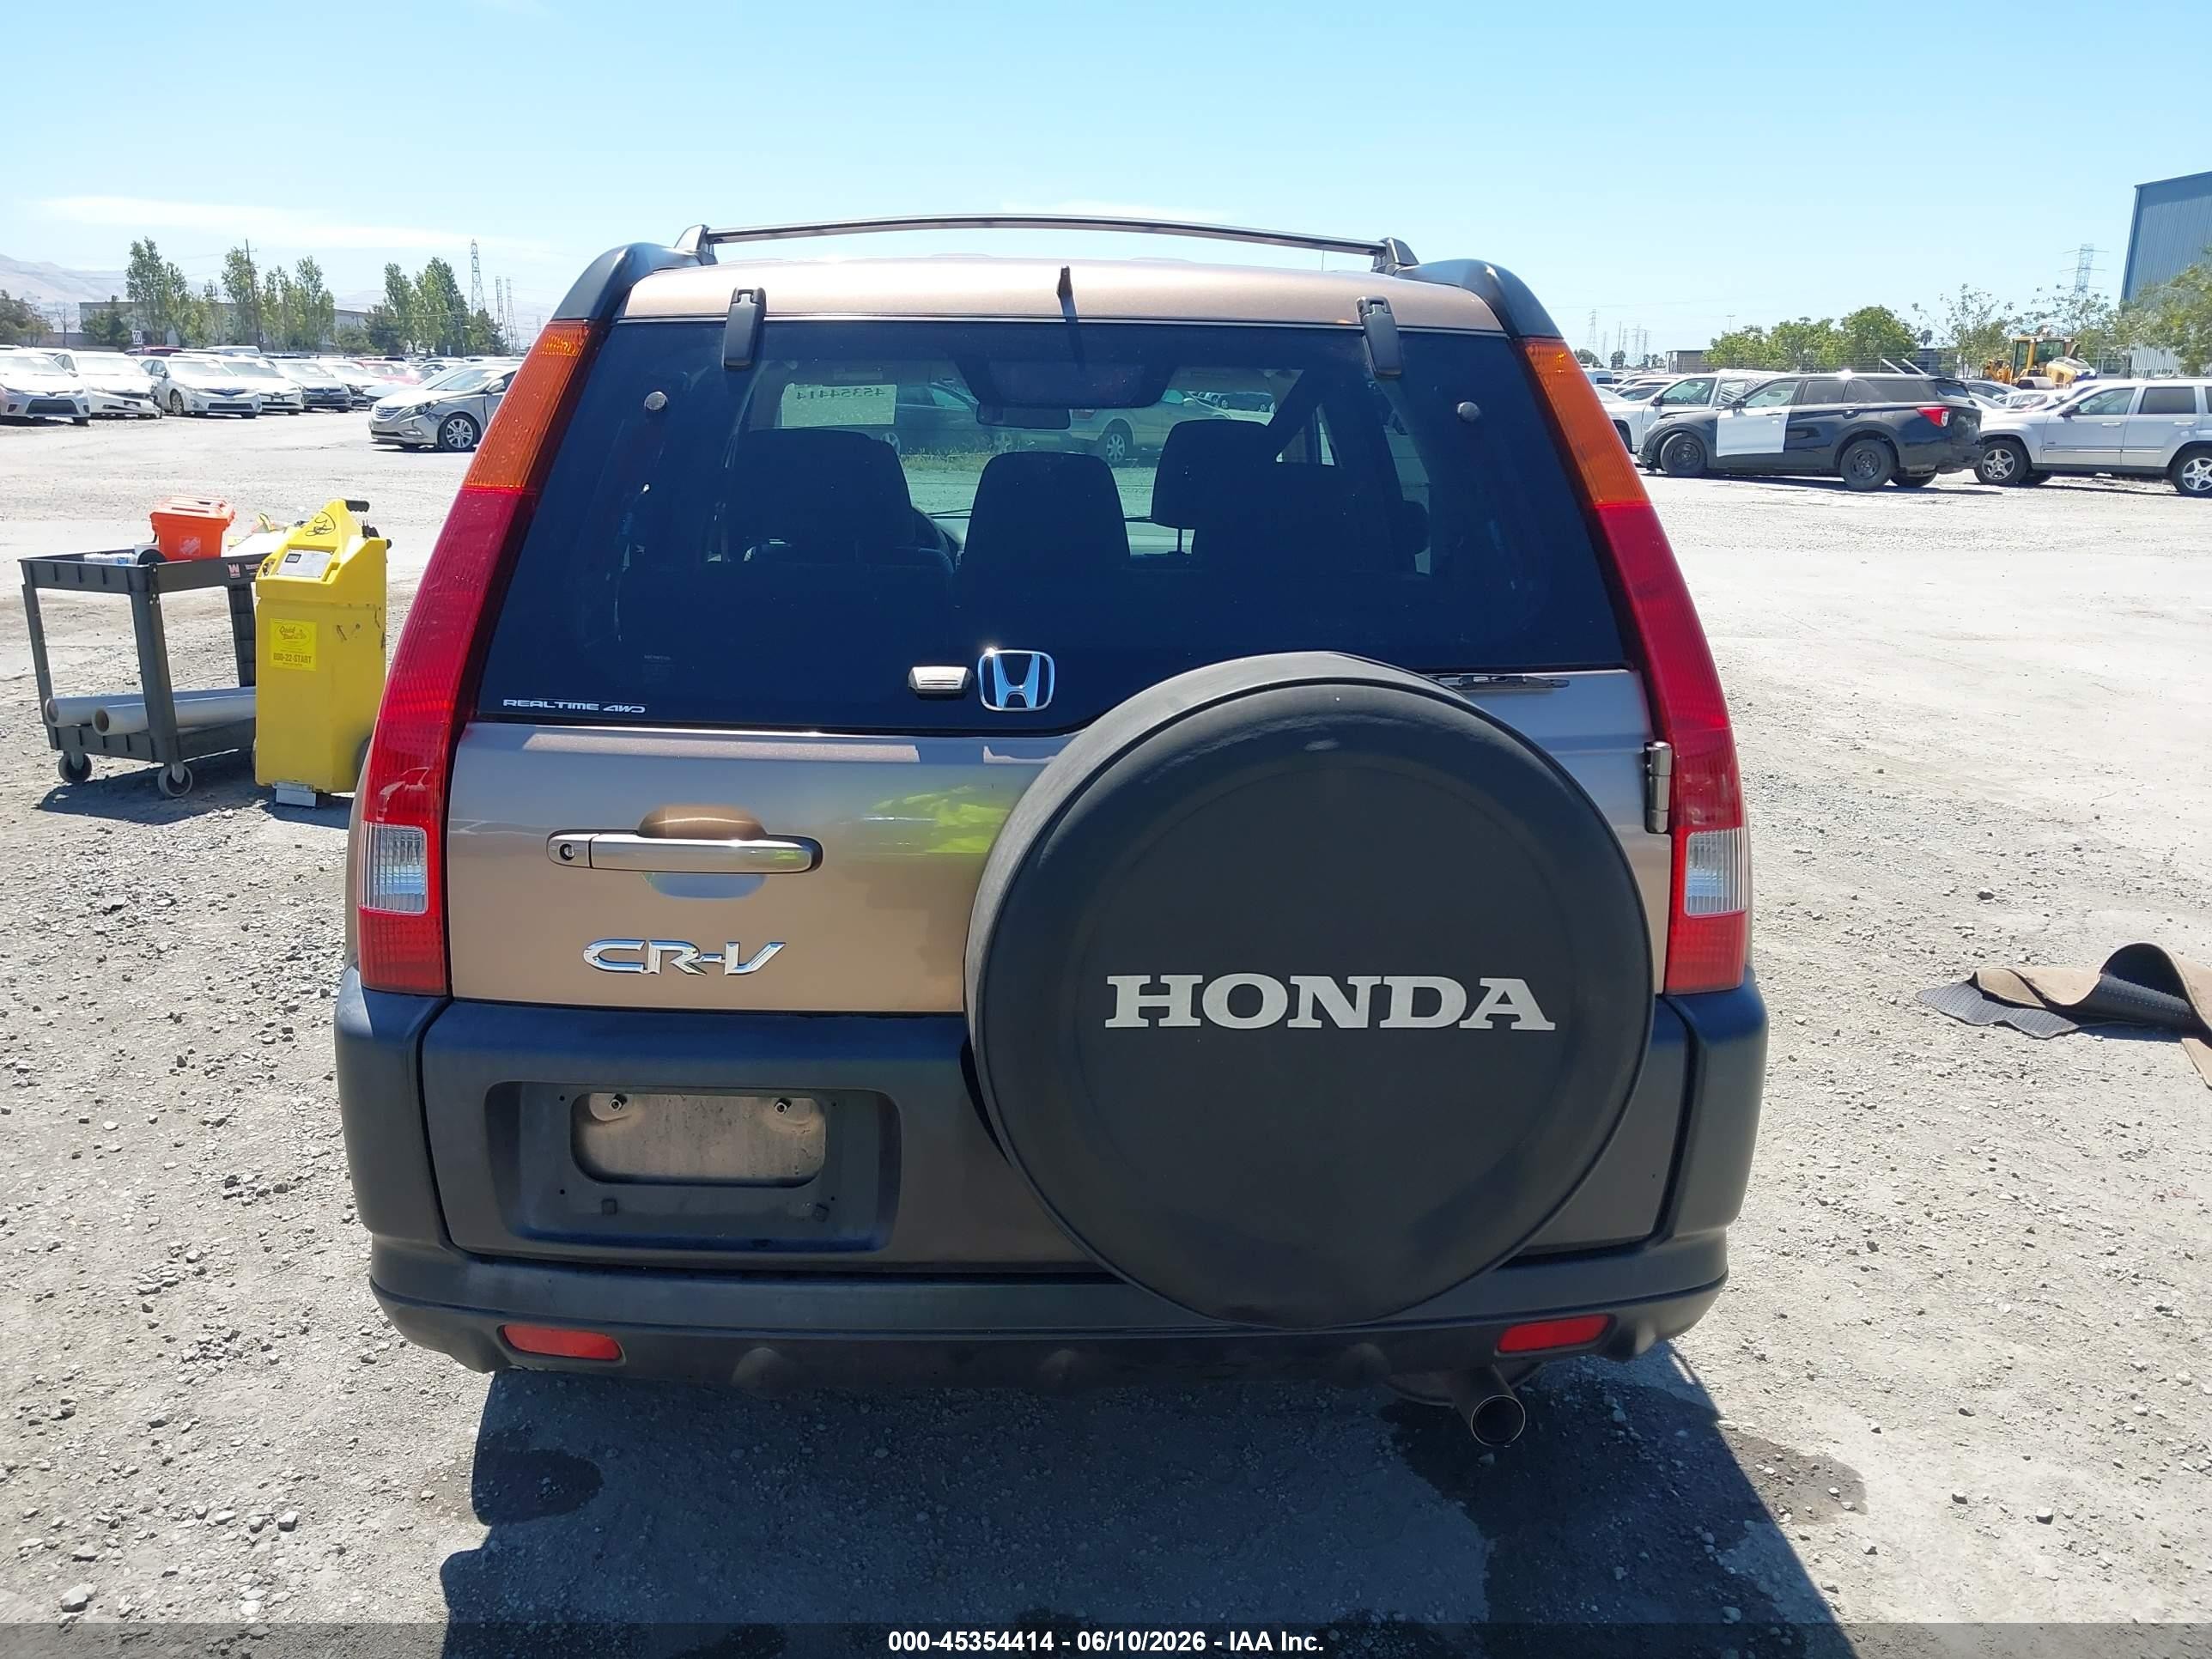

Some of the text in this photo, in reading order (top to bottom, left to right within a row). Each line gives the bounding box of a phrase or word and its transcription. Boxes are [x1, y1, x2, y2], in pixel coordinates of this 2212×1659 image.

[133, 331, 142, 343] 20
[502, 698, 647, 714] REALTIME 4WD
[583, 939, 787, 975] CR-V
[1105, 973, 1556, 1030] HONDA
